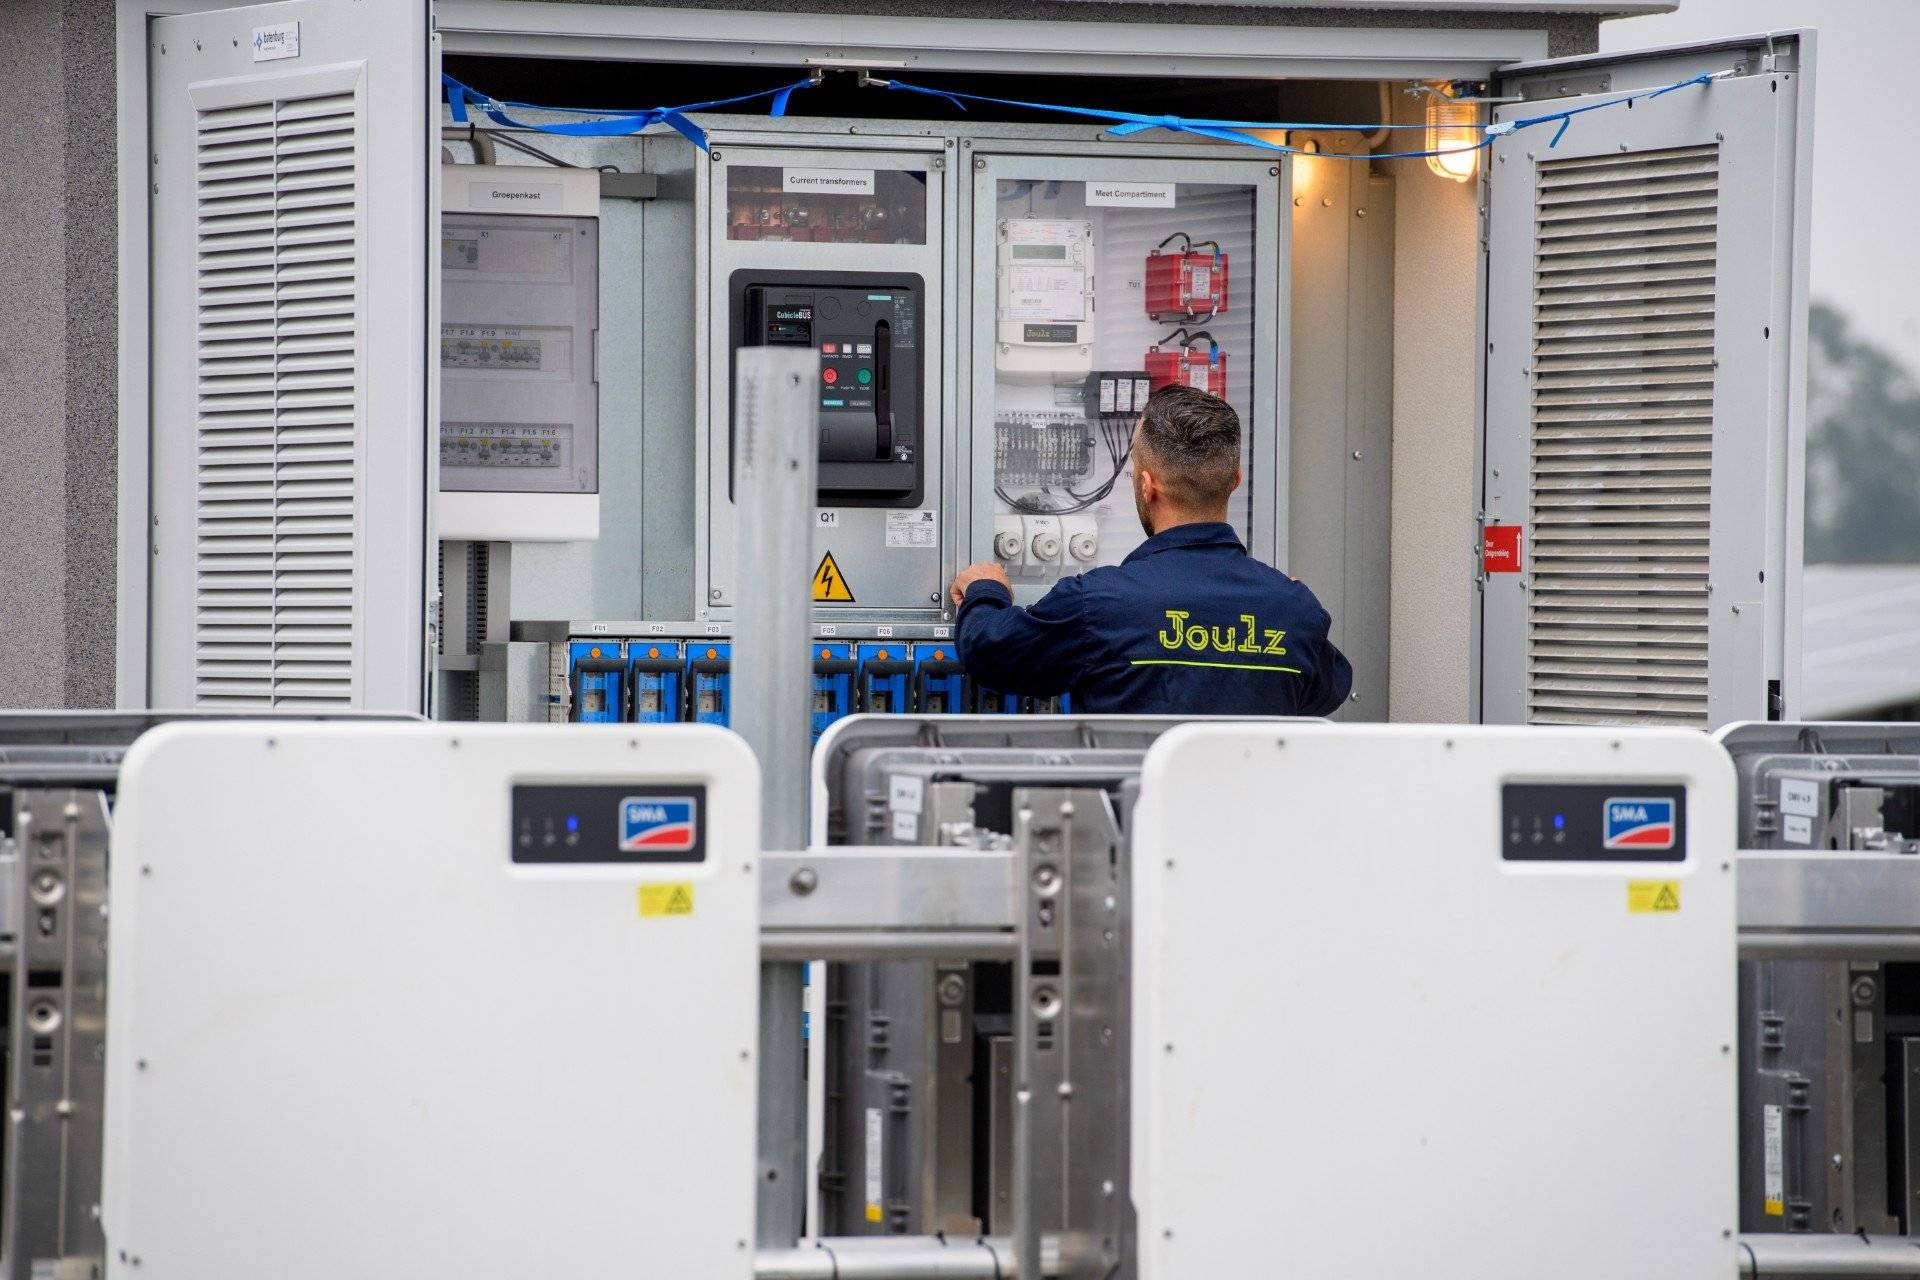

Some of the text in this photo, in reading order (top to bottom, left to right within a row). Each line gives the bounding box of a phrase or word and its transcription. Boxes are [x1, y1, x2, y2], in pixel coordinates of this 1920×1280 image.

[789, 176, 868, 187] Current transformers
[492, 190, 541, 200] Groepenkast
[1095, 189, 1166, 200] Meet Compartiment
[820, 512, 835, 523] Q1
[651, 625, 664, 633] F02
[822, 627, 835, 635] F05
[879, 628, 891, 636] F06
[935, 628, 947, 636] F07
[1159, 610, 1287, 656] Joulz
[627, 805, 668, 823] SMA
[1611, 805, 1648, 823] SMA
